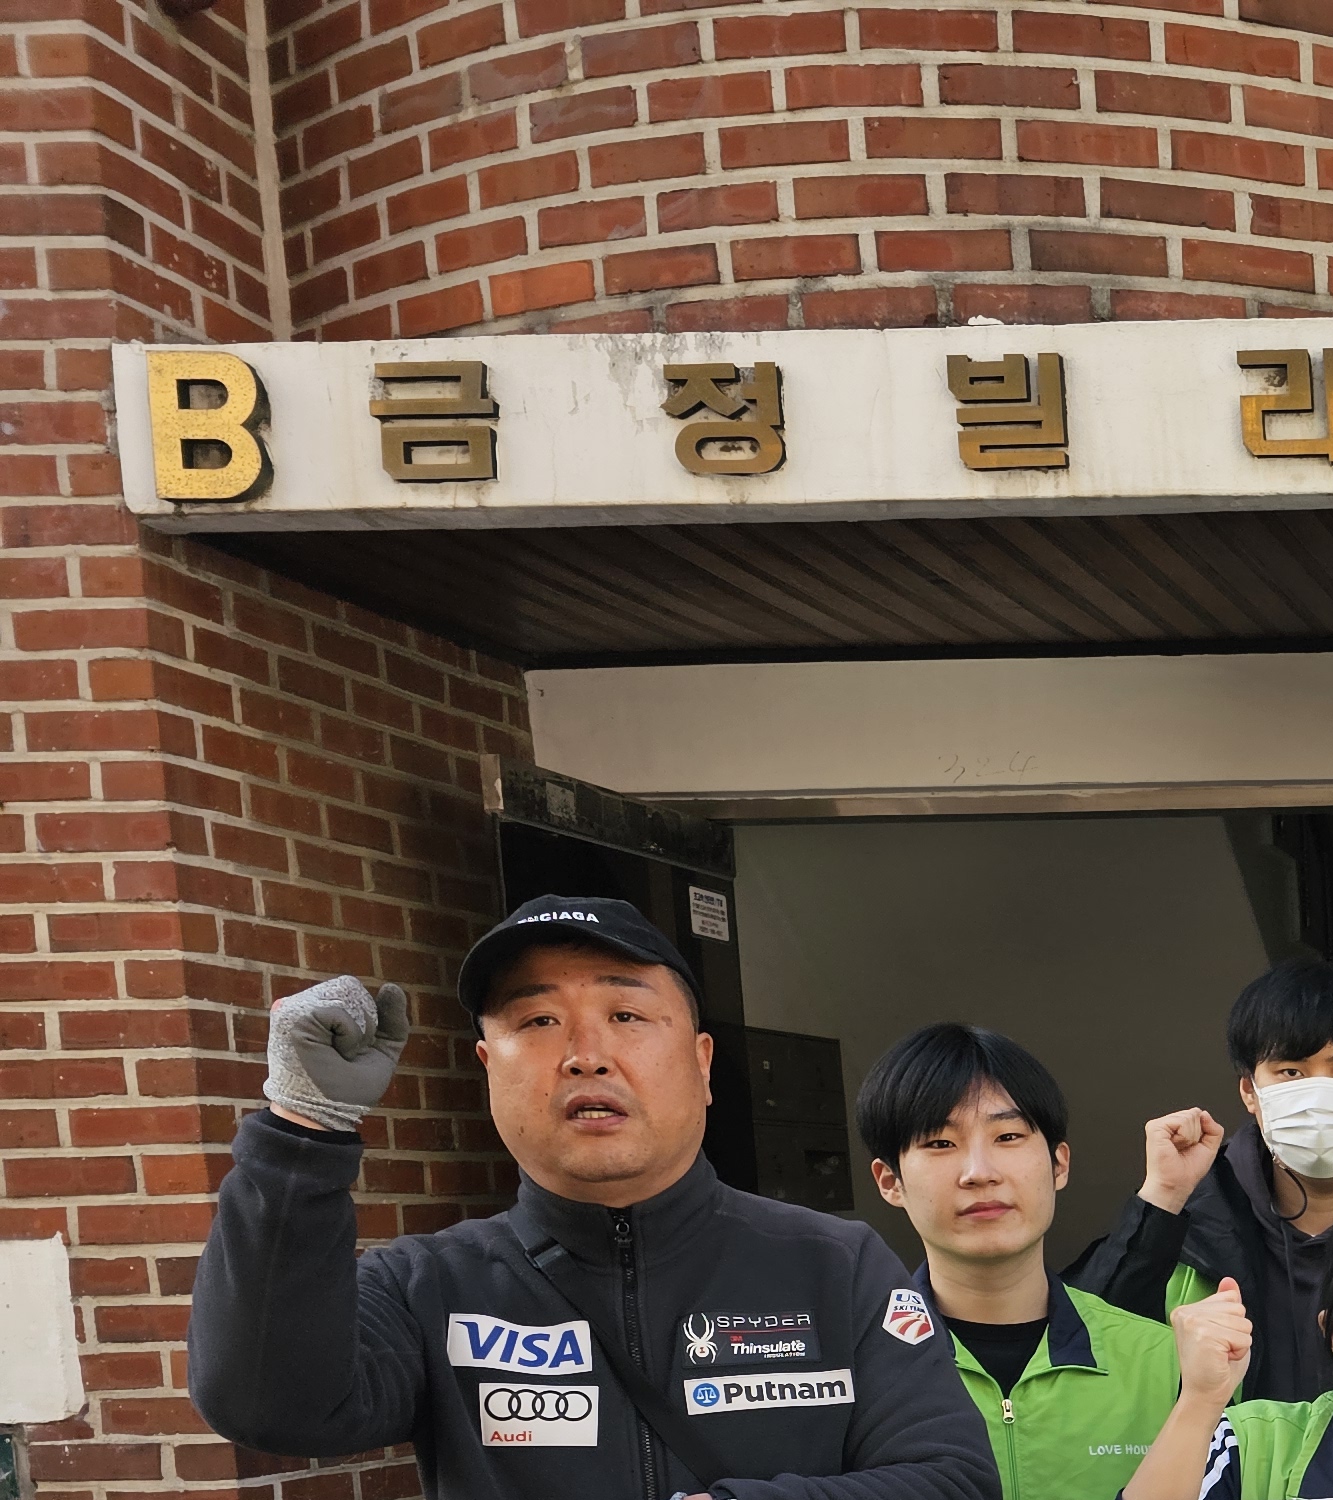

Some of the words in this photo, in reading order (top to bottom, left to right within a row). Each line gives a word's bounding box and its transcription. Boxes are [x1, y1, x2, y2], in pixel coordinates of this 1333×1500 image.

[146, 350, 268, 502] B
[896, 1293, 921, 1305] US
[716, 1313, 811, 1328] SPYDER
[454, 1320, 585, 1369] VISA
[730, 1340, 806, 1355] Thinsulate
[723, 1379, 847, 1405] Putnam
[489, 1430, 533, 1443] Audi
[1088, 1444, 1123, 1456] LOVE
[1124, 1443, 1153, 1456] HOU
